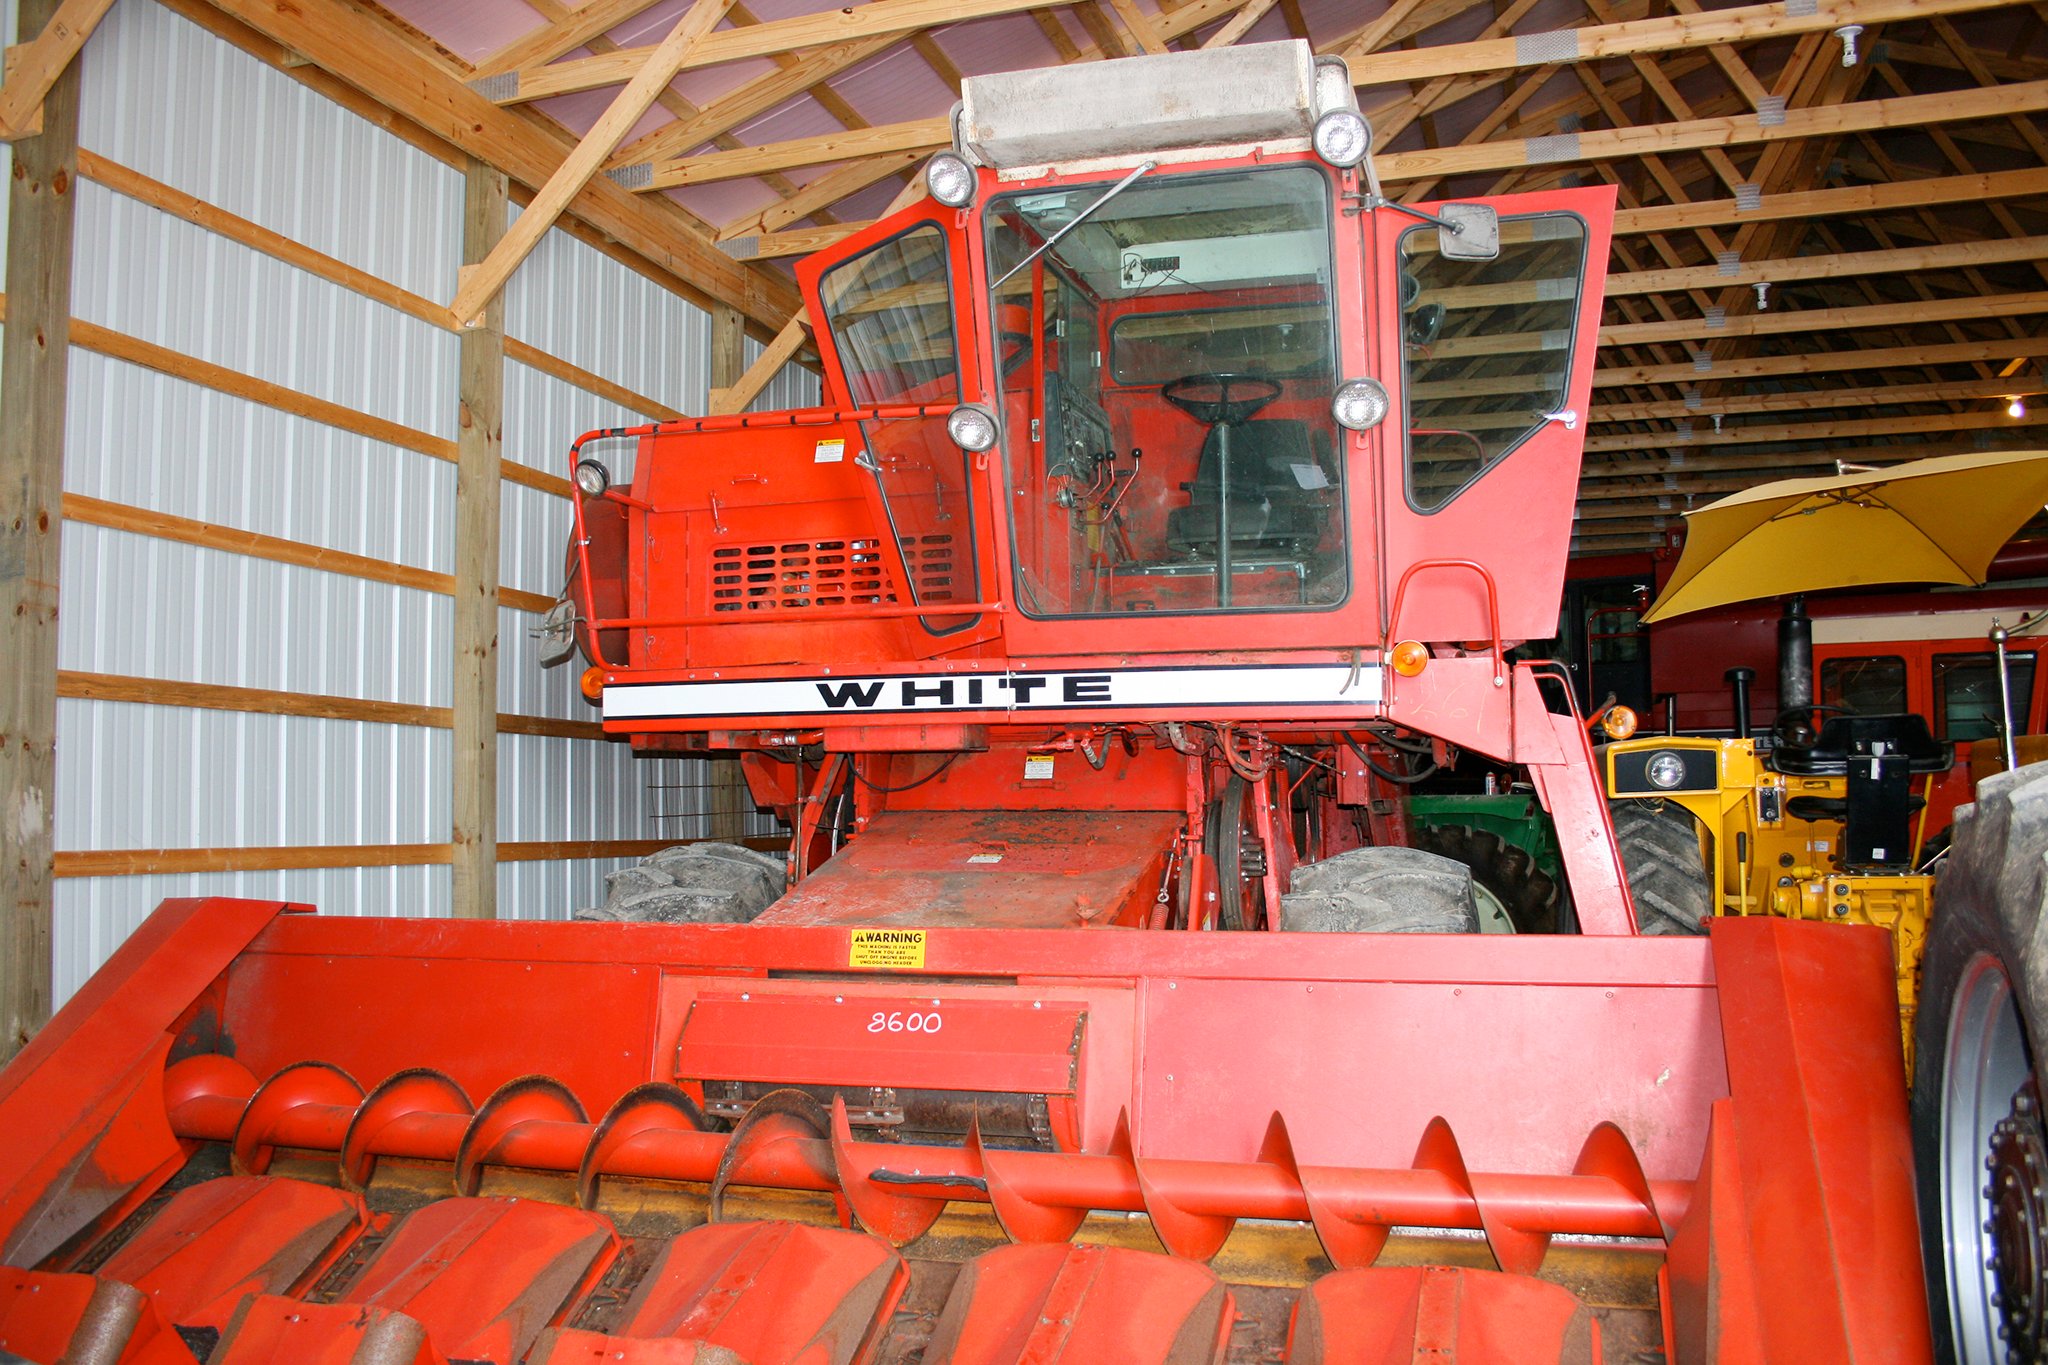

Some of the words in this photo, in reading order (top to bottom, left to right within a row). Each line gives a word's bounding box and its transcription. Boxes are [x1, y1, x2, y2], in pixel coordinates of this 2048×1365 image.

[815, 675, 1112, 708] WHITE
[865, 932, 922, 943] WARNING
[866, 1011, 942, 1034] 8600
